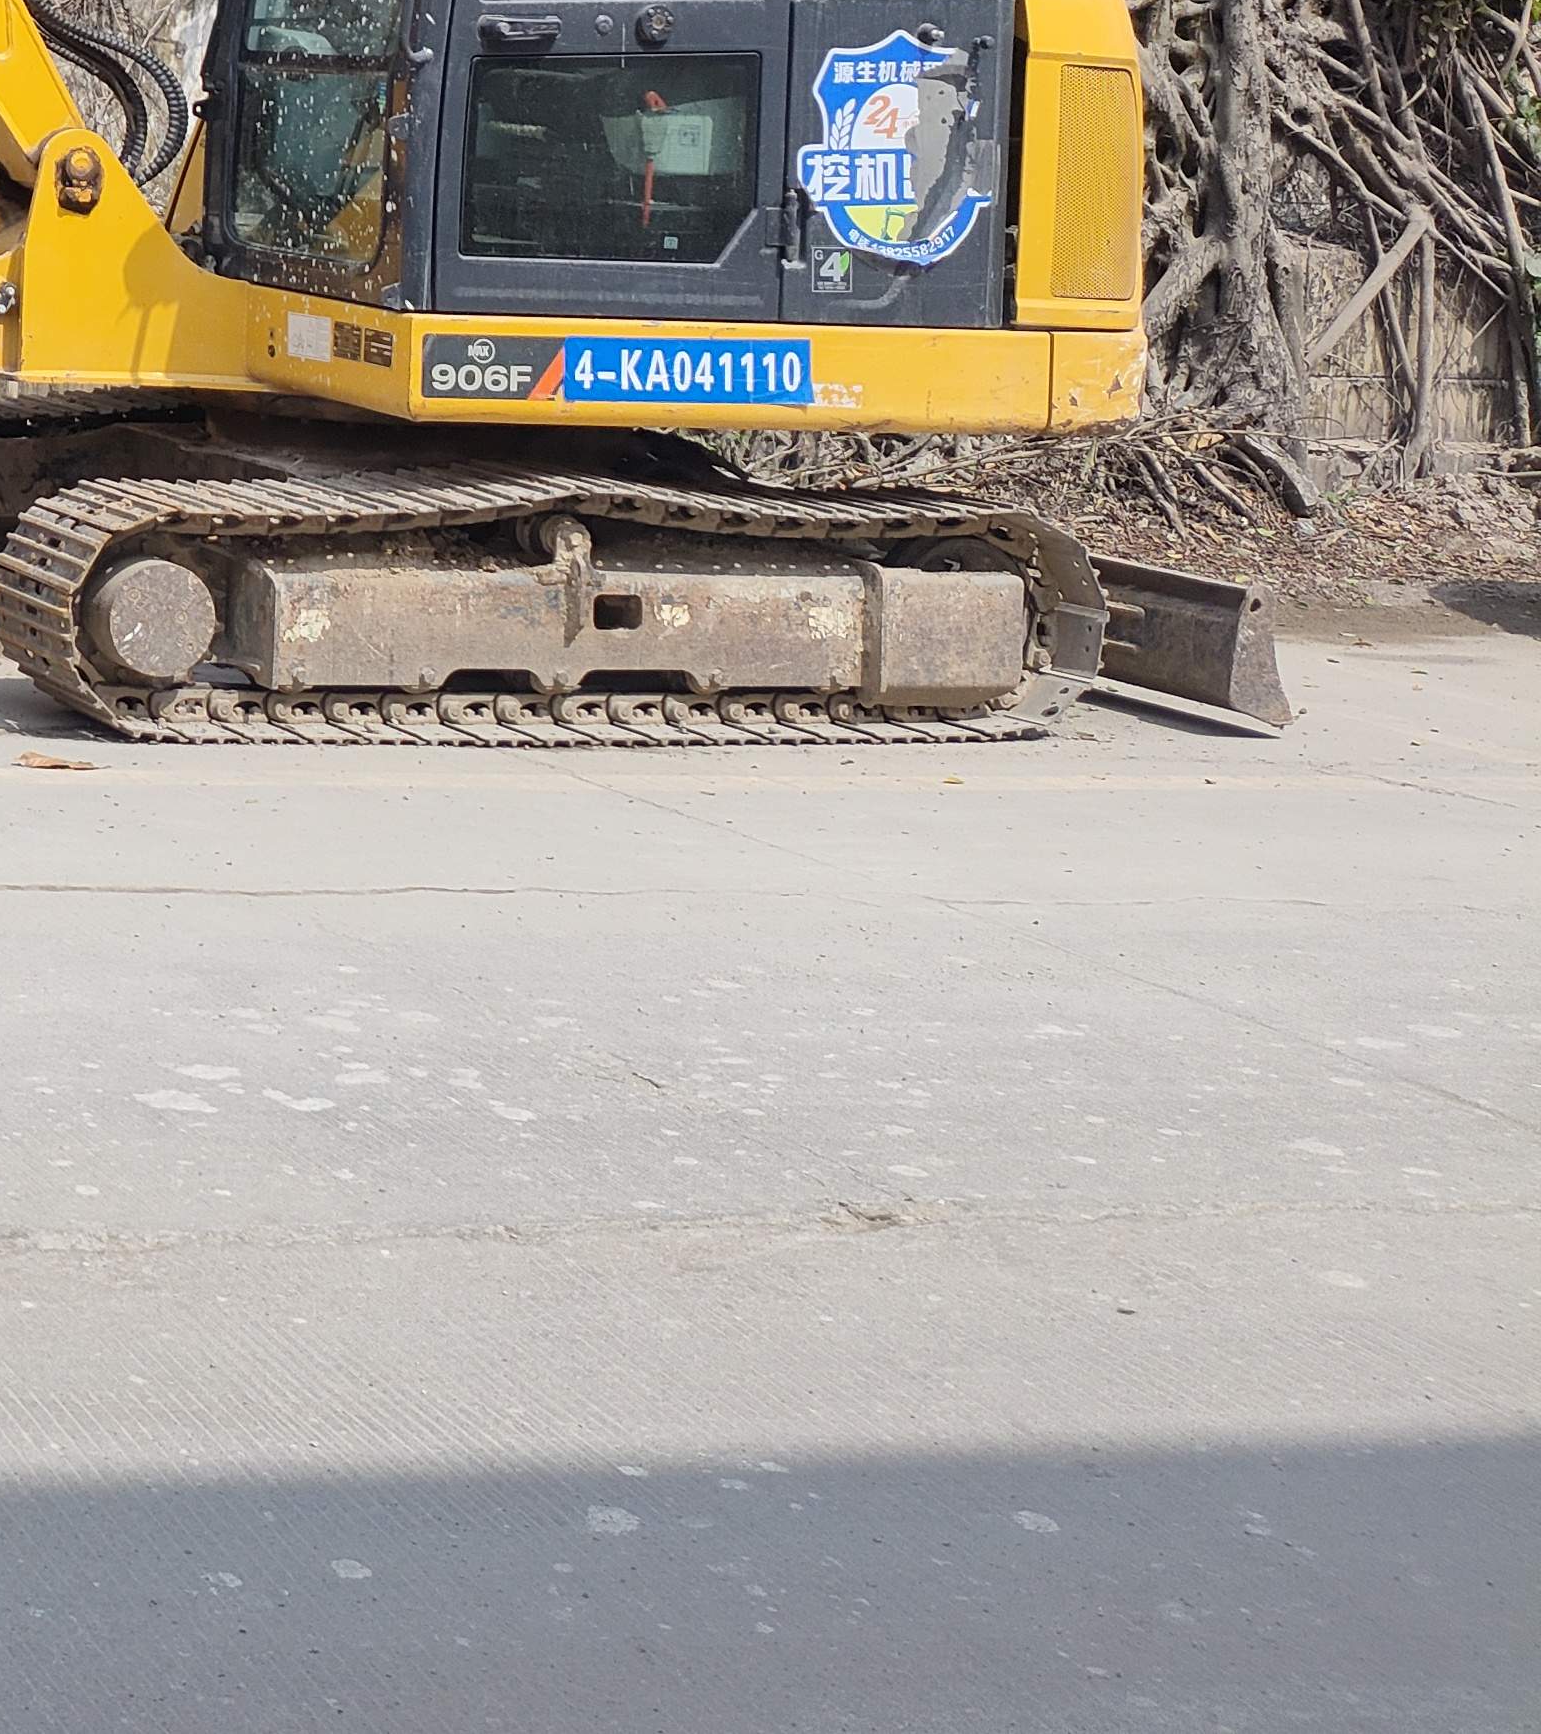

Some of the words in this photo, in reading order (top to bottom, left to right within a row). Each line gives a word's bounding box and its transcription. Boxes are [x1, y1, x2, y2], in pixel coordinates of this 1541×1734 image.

[863, 94, 900, 139] 24
[431, 363, 533, 393] 906F
[574, 348, 802, 394] 4-KA041110
